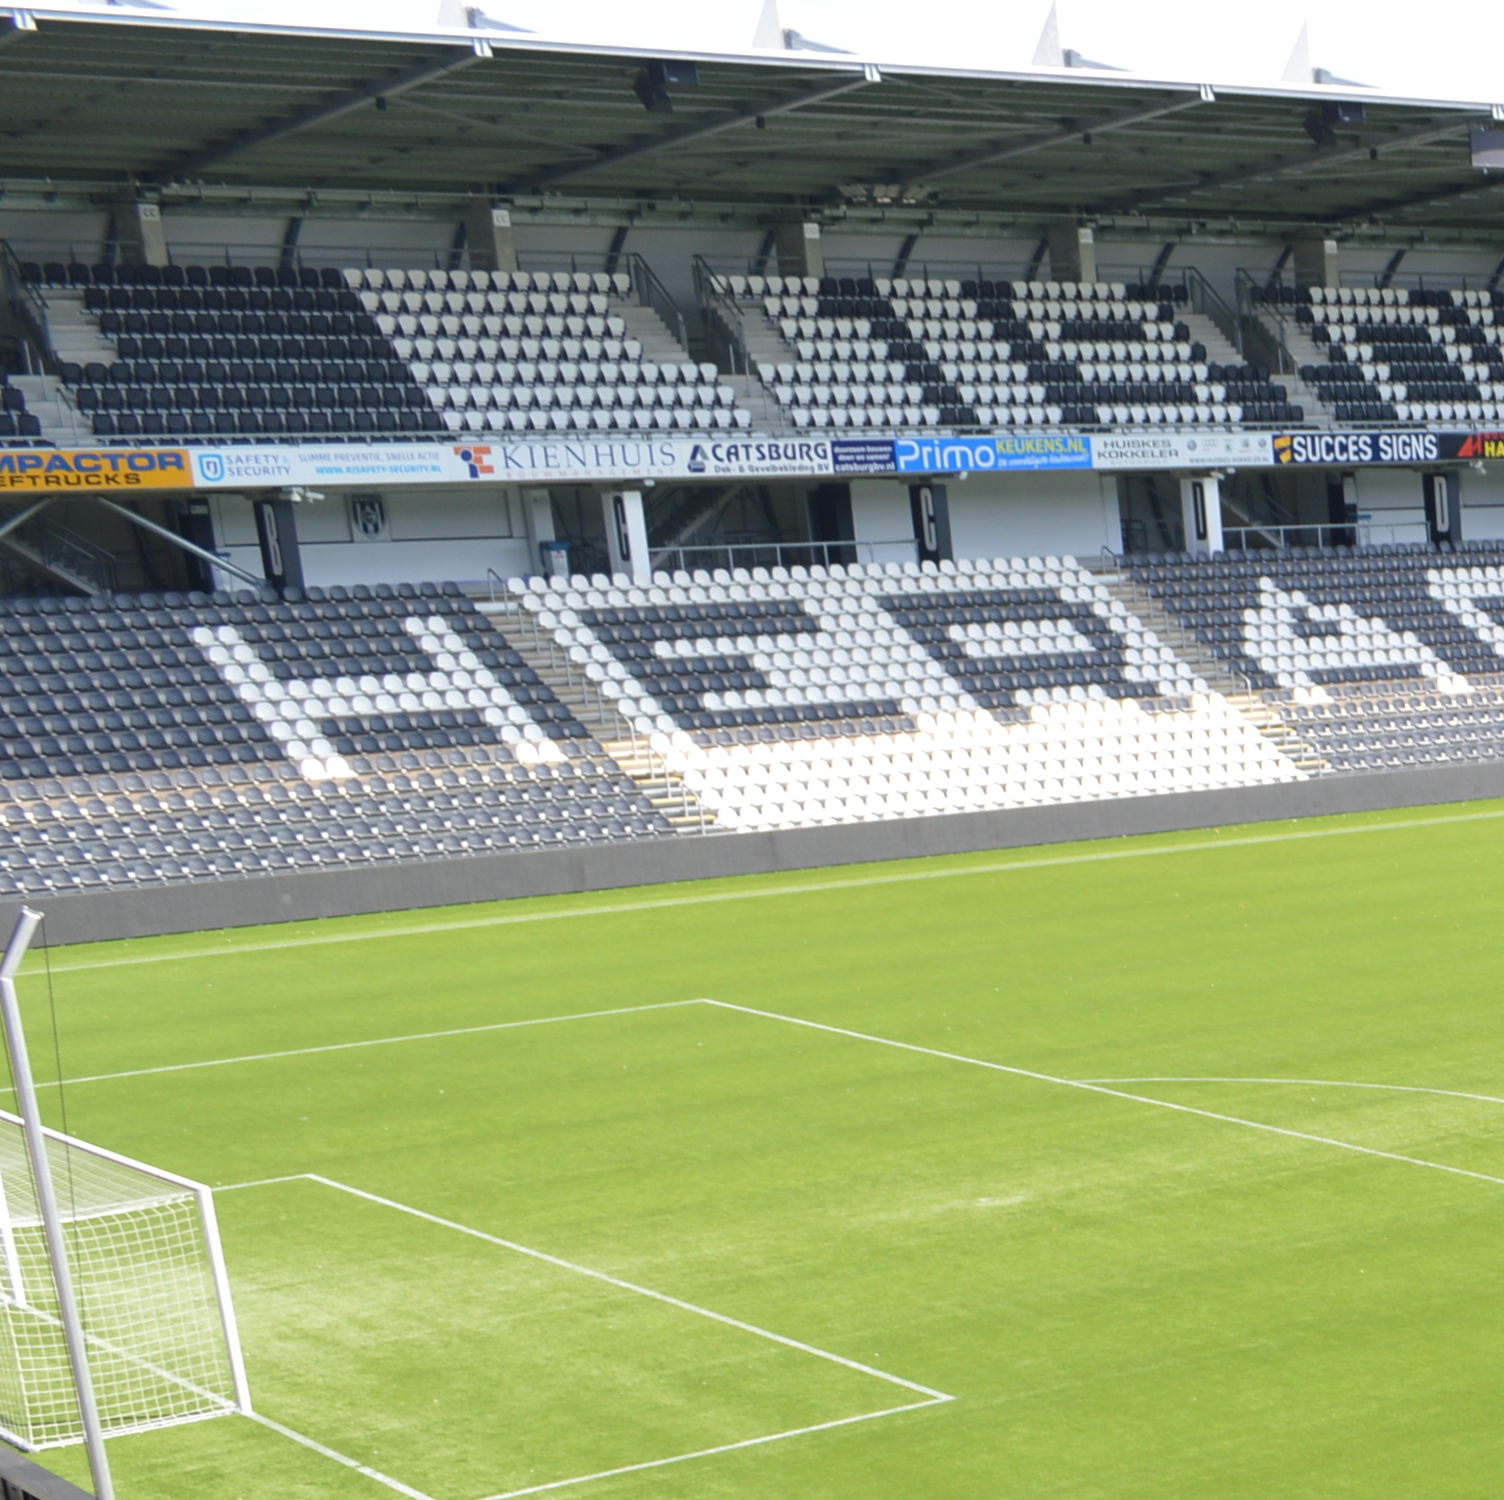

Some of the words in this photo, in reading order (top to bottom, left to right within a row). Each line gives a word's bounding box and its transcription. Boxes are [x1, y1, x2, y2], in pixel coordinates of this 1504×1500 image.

[995, 437, 1090, 455] KEUKENS.NL
[1103, 438, 1172, 449] HUISKES
[1292, 434, 1373, 463] SUCCES
[1378, 433, 1439, 462] SIGNS
[226, 453, 280, 465] SAFETY
[298, 453, 332, 463] SLIMME
[385, 452, 416, 462] SNELLE
[416, 451, 441, 461] ACTIE
[502, 442, 677, 470] KIENHUIS
[711, 442, 829, 463] CATSBURG
[897, 438, 995, 470] Primo
[1097, 448, 1180, 460] KOKKELER
[227, 464, 292, 477] SECURITY
